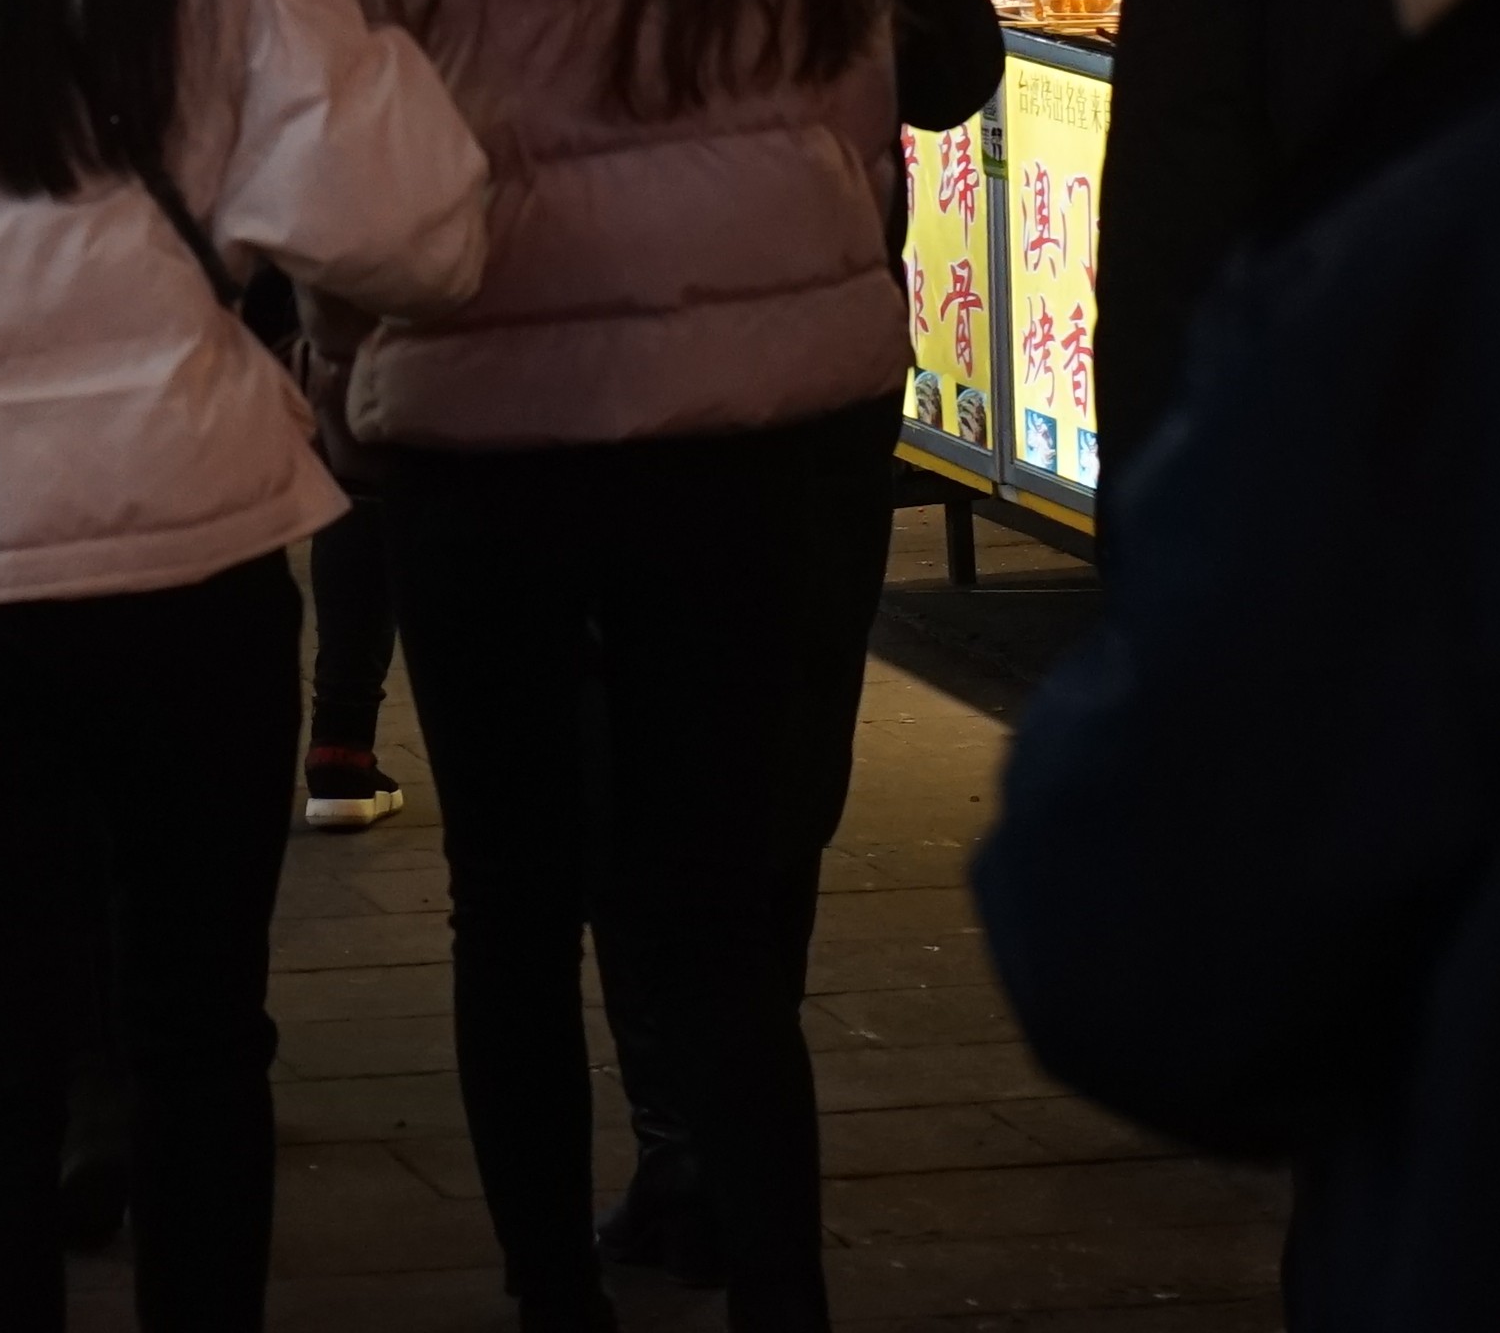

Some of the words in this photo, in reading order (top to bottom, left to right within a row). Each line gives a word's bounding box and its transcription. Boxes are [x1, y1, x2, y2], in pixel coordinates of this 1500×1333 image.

[1017, 70, 1088, 132] 台湾烤出名堂
[1021, 160, 1098, 293] 澳门
[1022, 295, 1096, 419] 烤香
